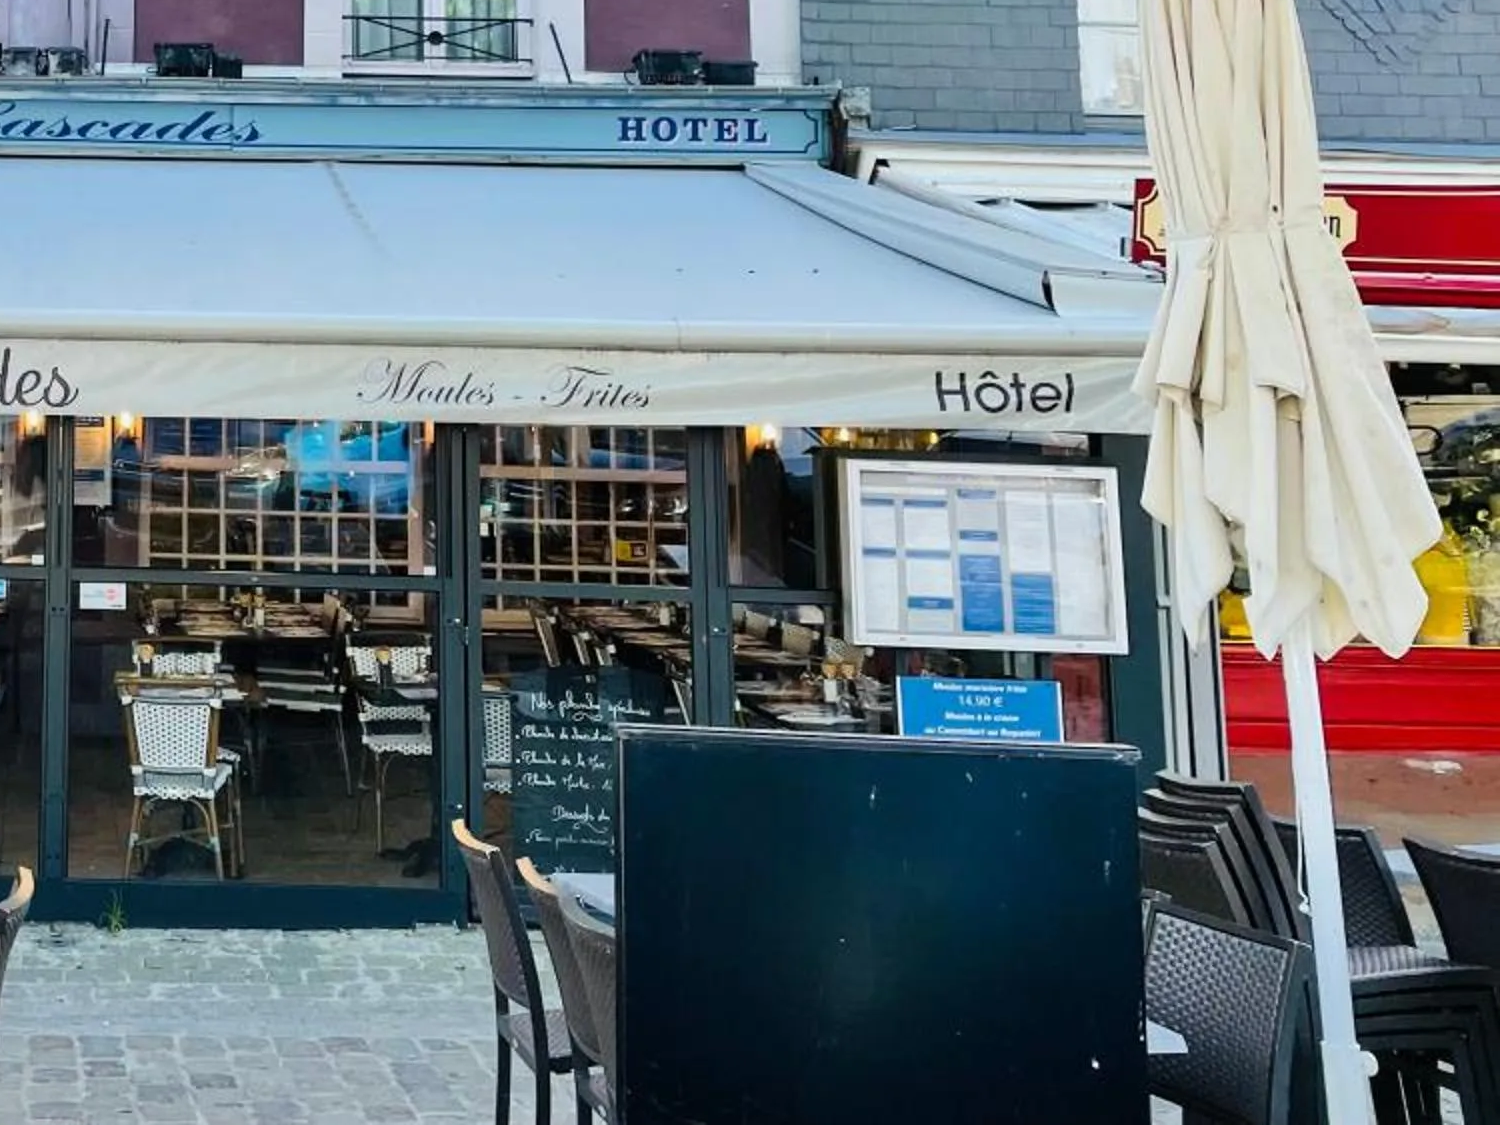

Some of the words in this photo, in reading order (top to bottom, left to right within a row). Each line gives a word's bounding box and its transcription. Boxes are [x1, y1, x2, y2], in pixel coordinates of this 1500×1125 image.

[617, 116, 768, 143] HOTEL
[356, 357, 498, 406] Moules
[540, 363, 650, 408] Frites
[935, 370, 1074, 414] Hôtel
